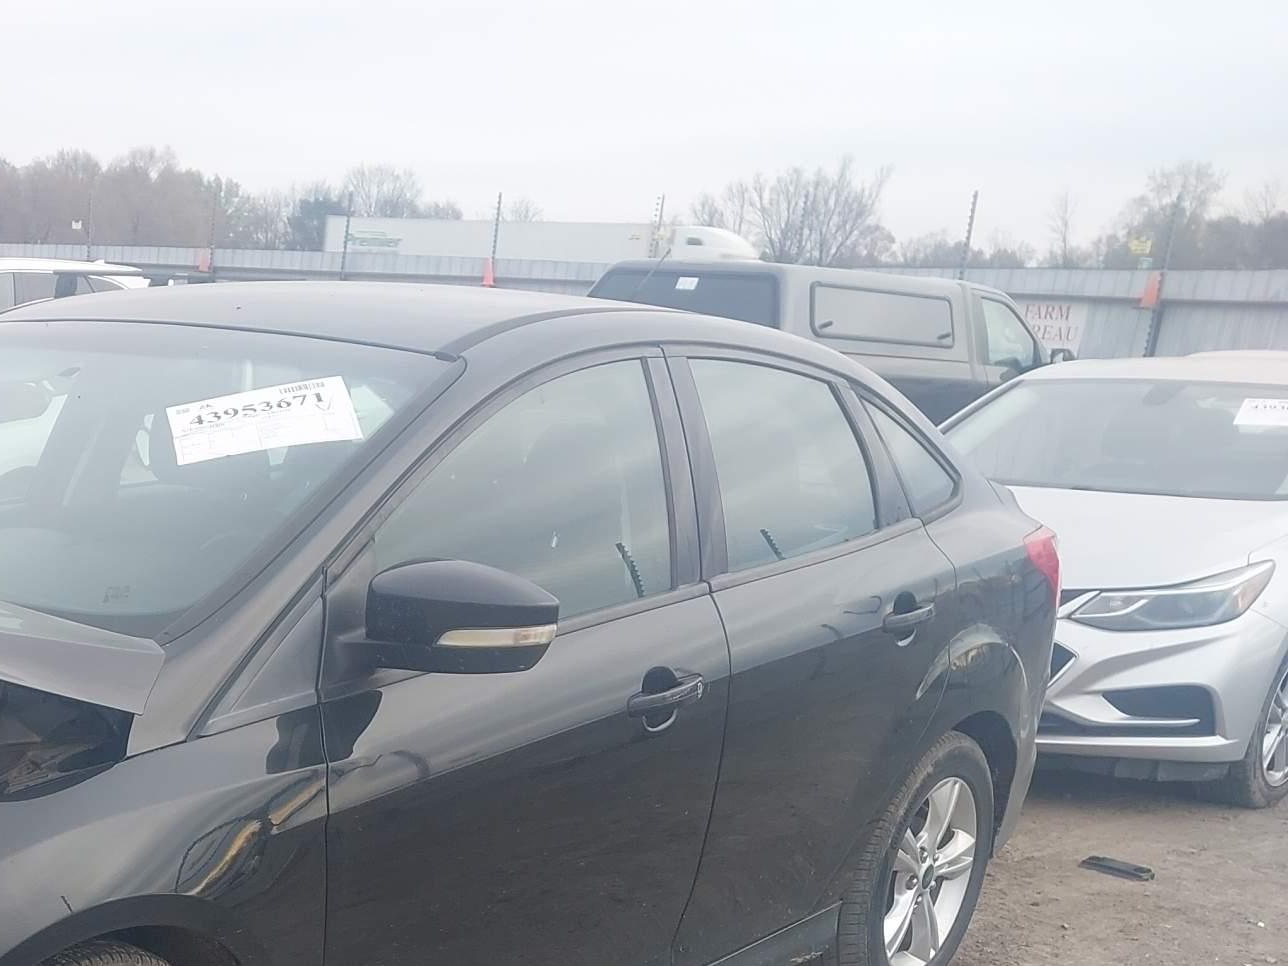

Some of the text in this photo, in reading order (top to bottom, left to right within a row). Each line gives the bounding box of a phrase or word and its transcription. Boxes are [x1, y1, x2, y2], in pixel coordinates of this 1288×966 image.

[1025, 304, 1071, 320] FARM
[1032, 325, 1079, 341] REAU
[189, 392, 325, 426] 43953671
